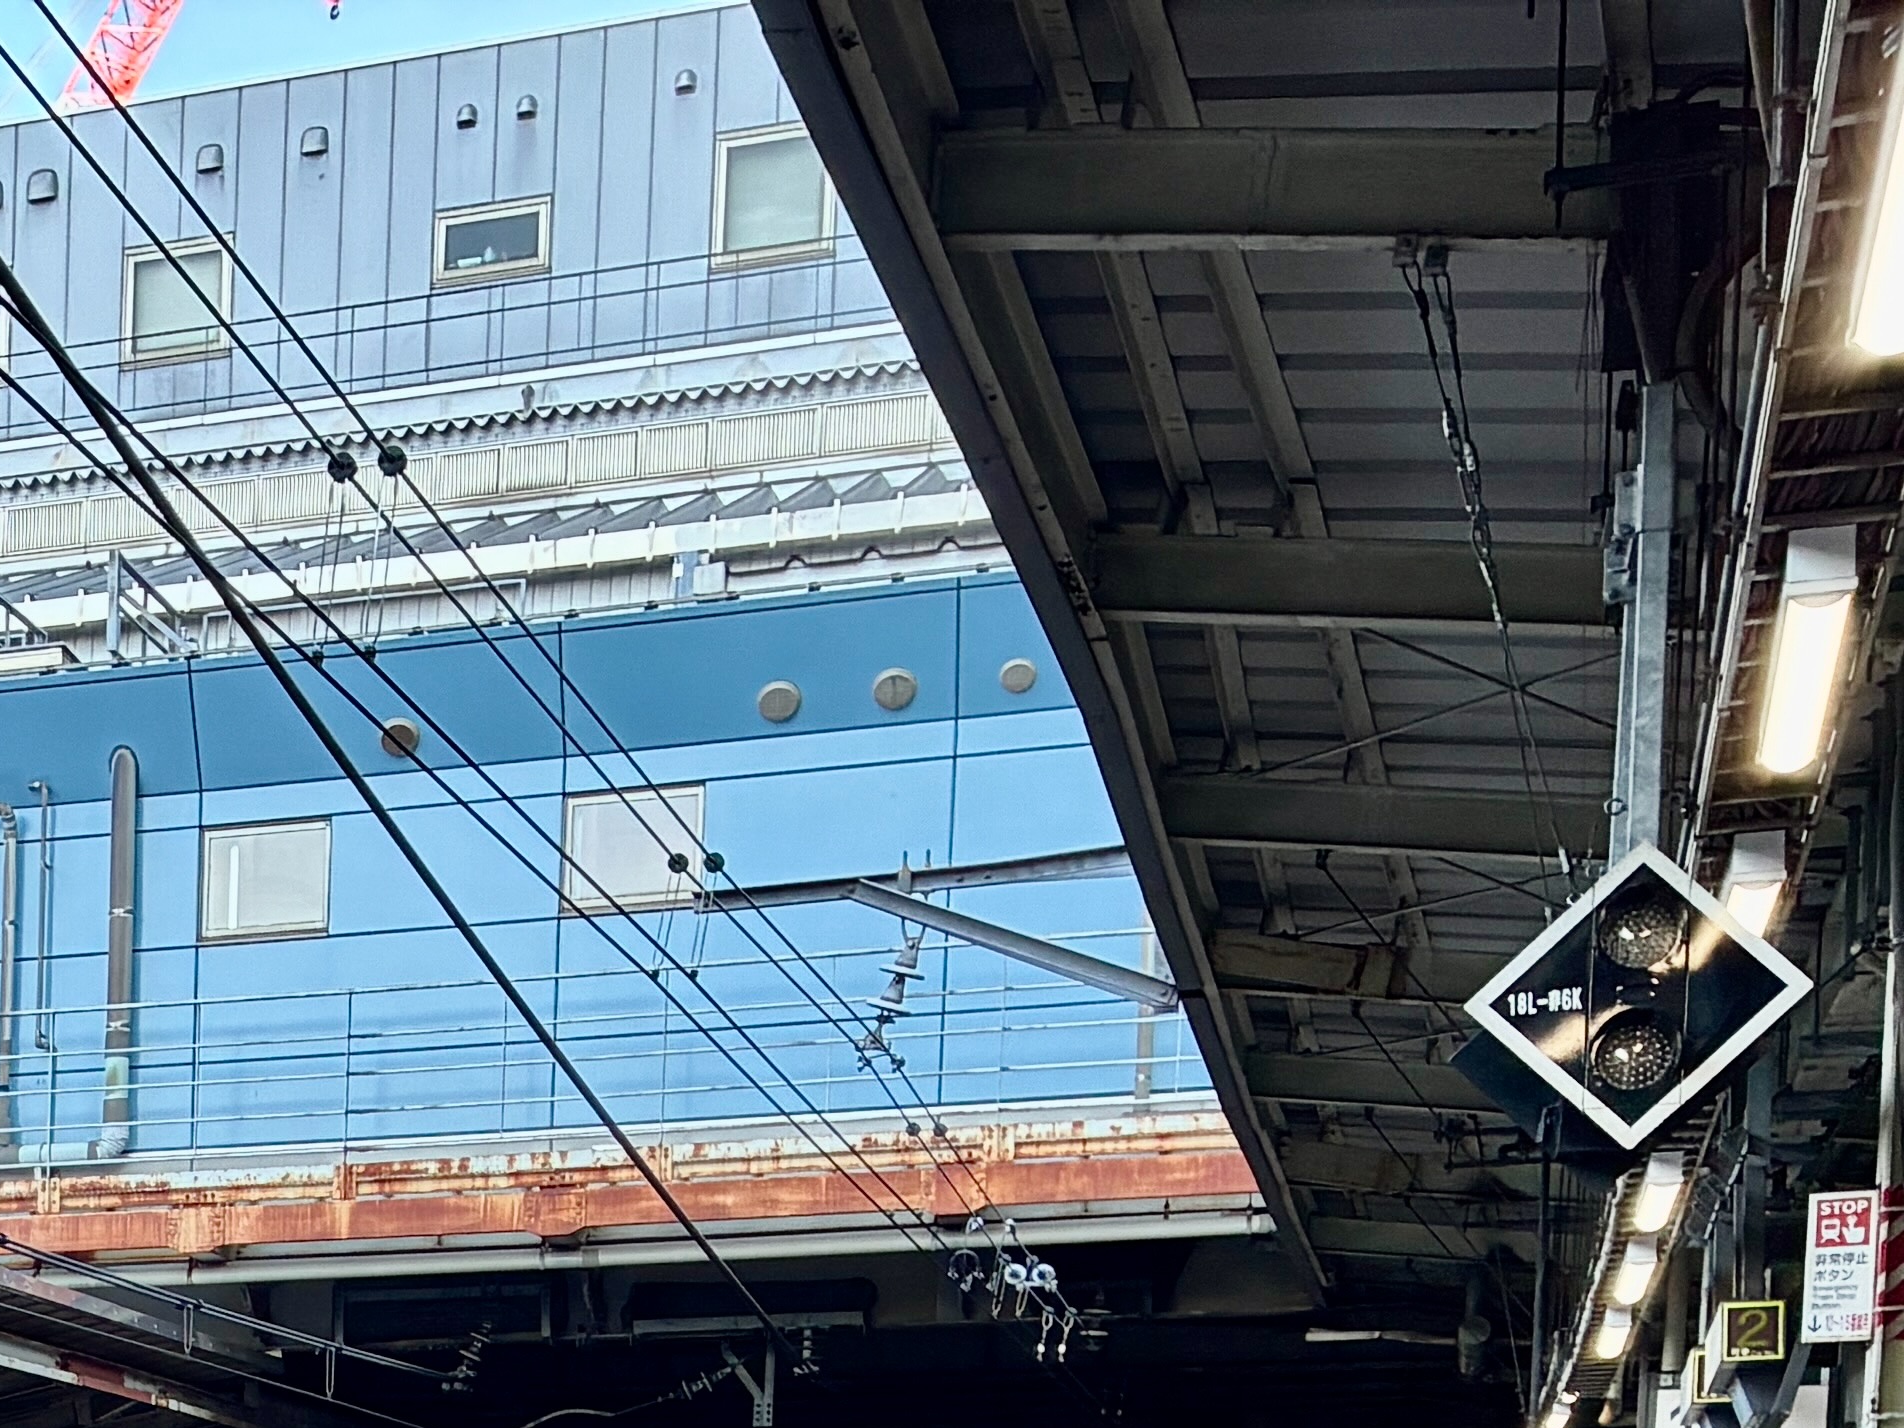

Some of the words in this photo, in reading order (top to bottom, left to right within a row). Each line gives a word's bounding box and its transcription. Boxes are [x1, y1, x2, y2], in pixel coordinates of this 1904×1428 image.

[1820, 1199, 1869, 1216] STOP
[1815, 1251, 1869, 1267] 非常停止
[1813, 1268, 1855, 1282] ボタン
[1736, 1308, 1769, 1347] 2
